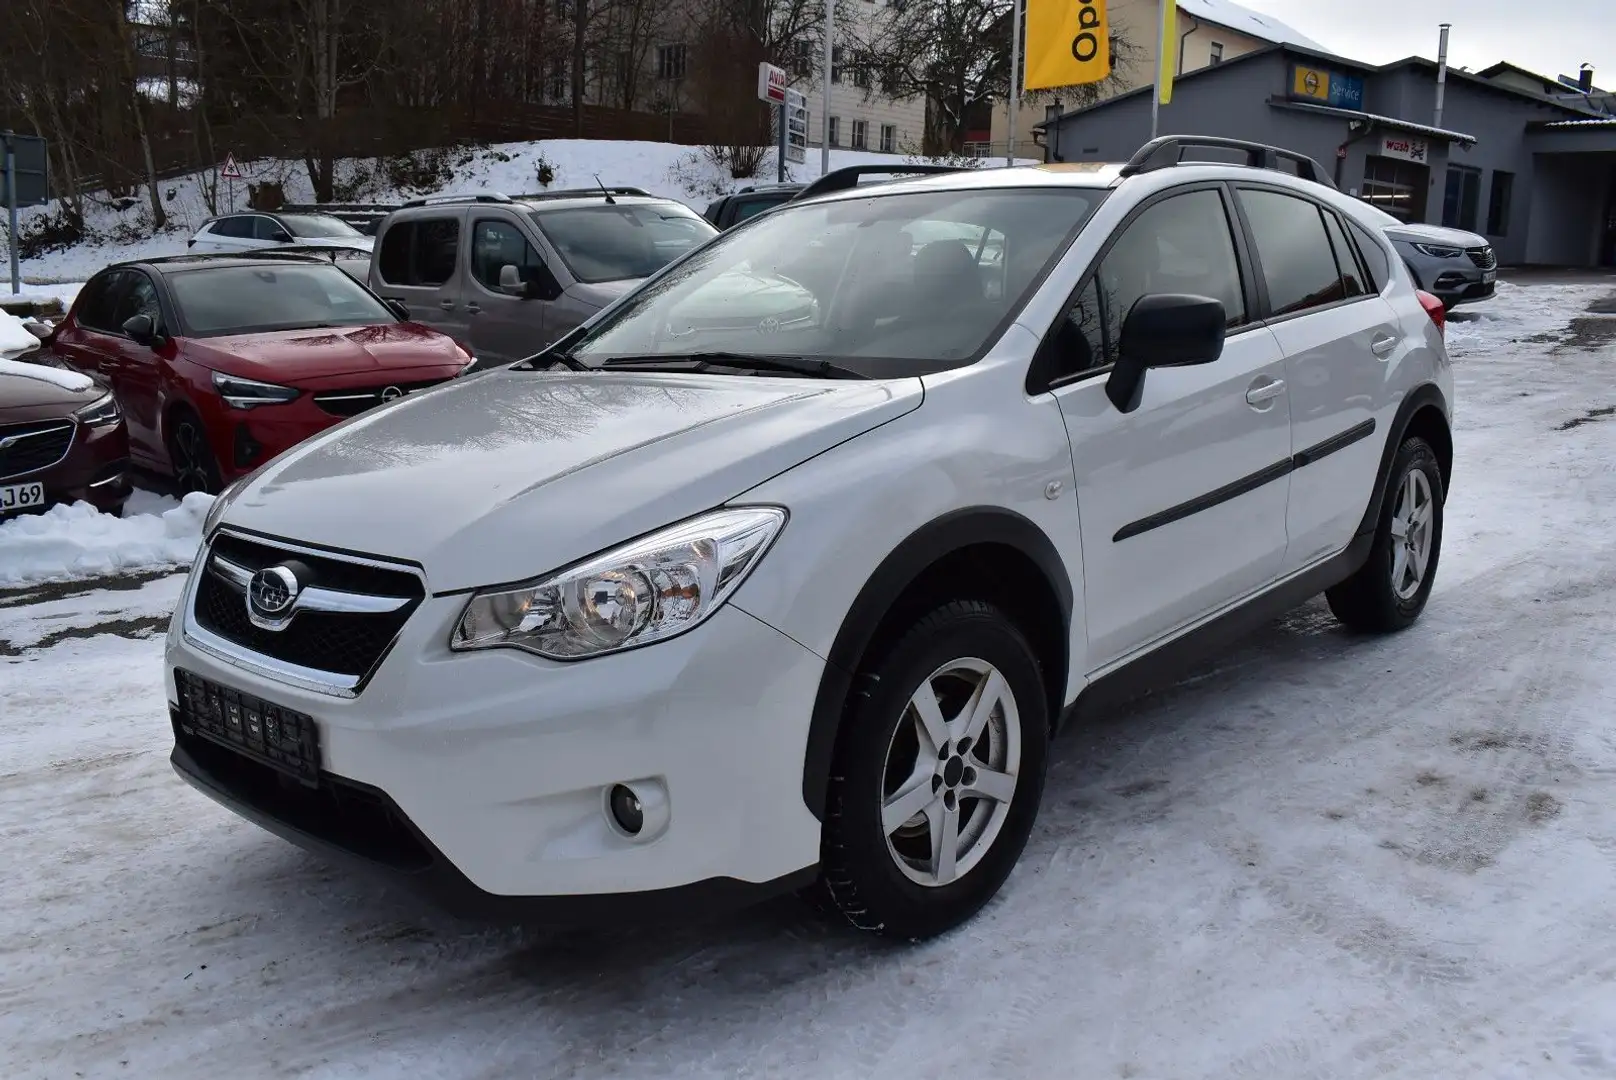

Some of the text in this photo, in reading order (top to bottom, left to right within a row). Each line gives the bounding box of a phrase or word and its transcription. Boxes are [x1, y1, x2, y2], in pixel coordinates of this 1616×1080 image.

[1072, 0, 1100, 62] Op
[769, 69, 785, 87] AVIA
[1332, 82, 1360, 101] Service
[19, 485, 41, 504] 69
